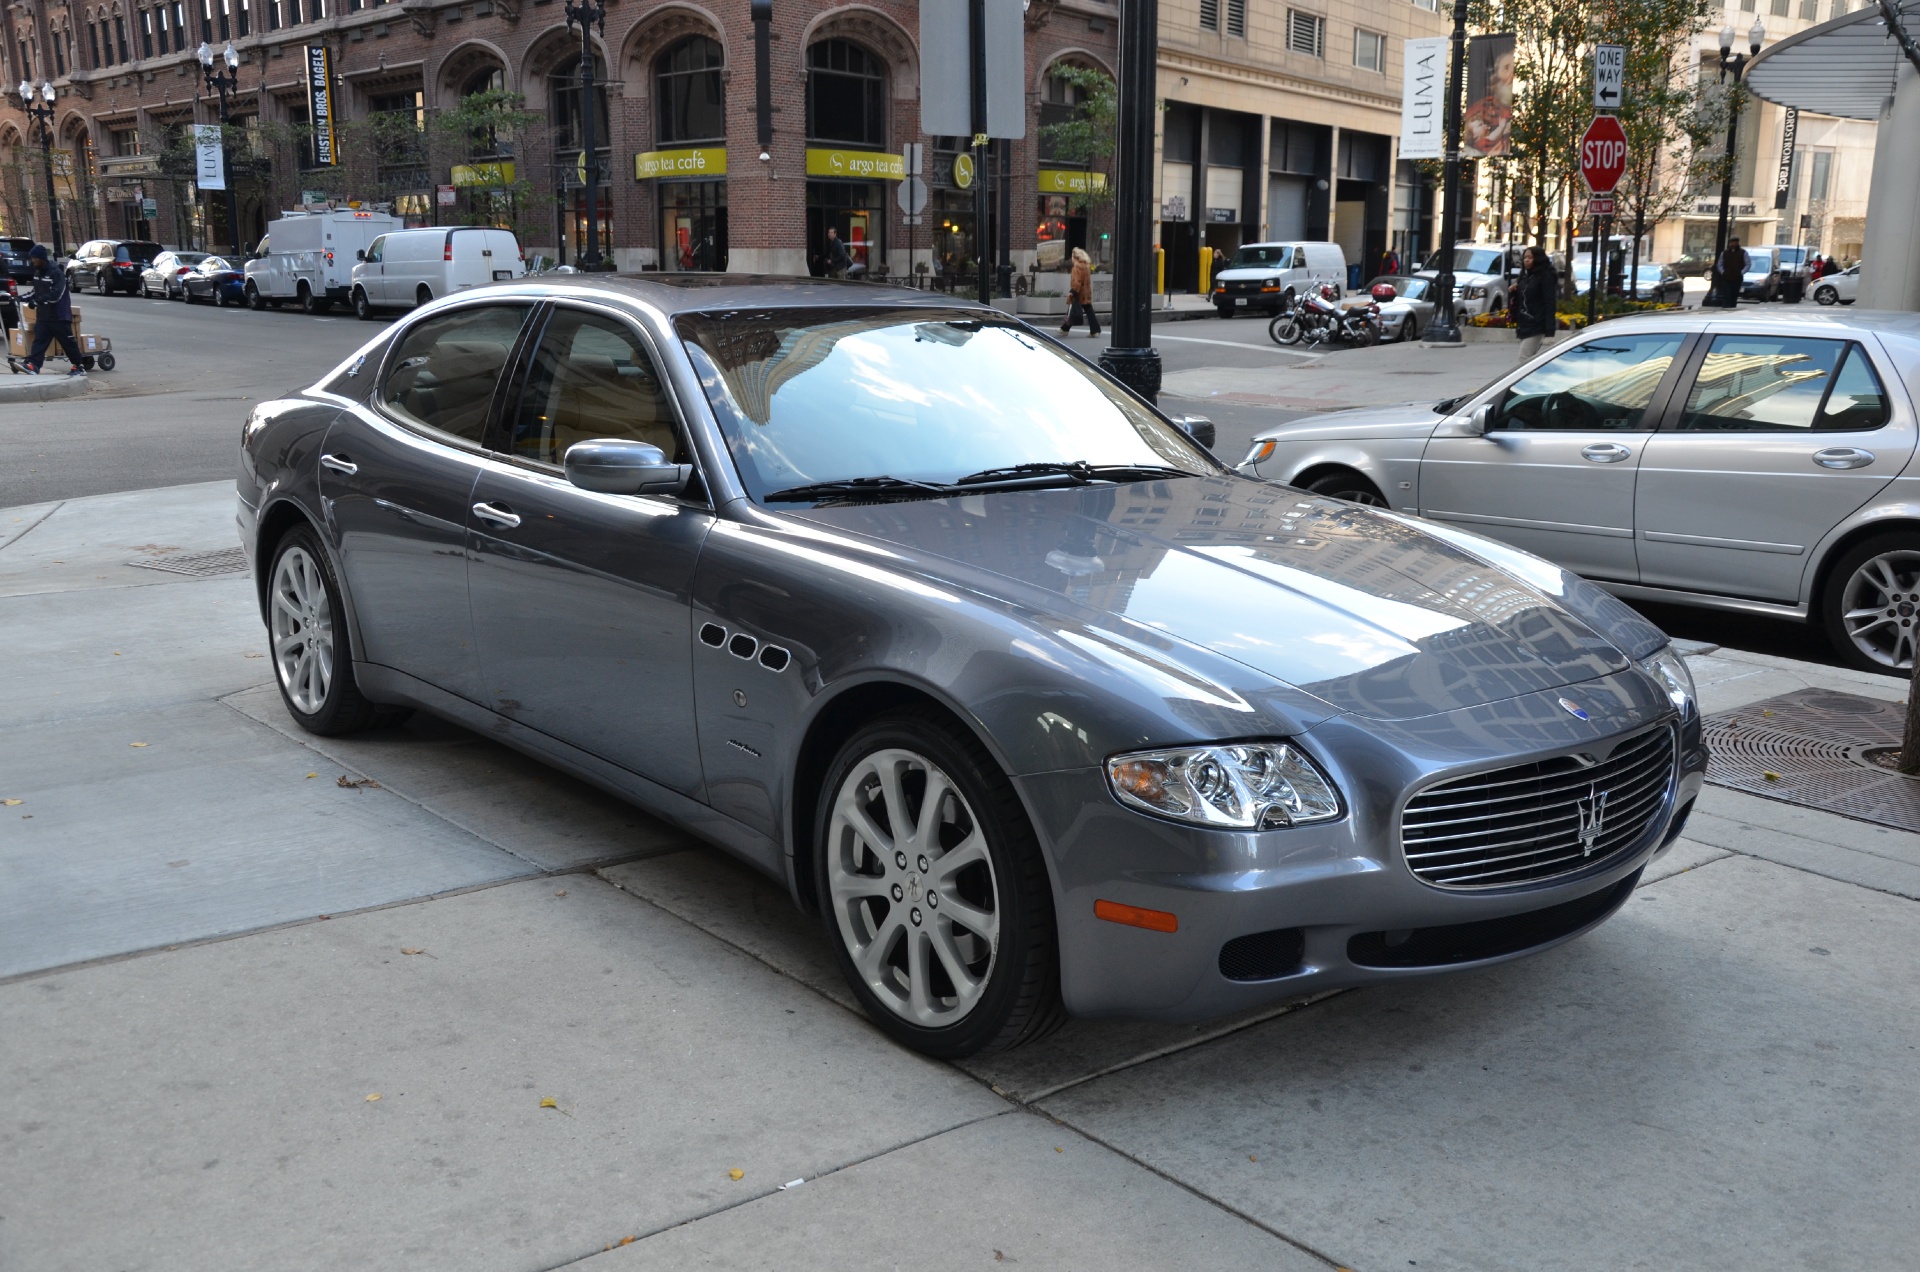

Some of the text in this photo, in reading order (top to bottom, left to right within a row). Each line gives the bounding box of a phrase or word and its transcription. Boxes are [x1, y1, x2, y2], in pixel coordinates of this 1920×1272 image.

[1600, 51, 1621, 66] ONE
[1599, 69, 1621, 83] WAY
[1413, 54, 1435, 134] LUMA
[312, 48, 331, 163] EINSTEIN BROS. BAGELS
[1584, 140, 1624, 169] STOP
[1777, 107, 1796, 192] ORDSTROM rack
[661, 157, 675, 170] tea
[677, 150, 706, 170] café
[849, 156, 904, 175] argo tea café
[1591, 201, 1613, 211] ALL WAY
